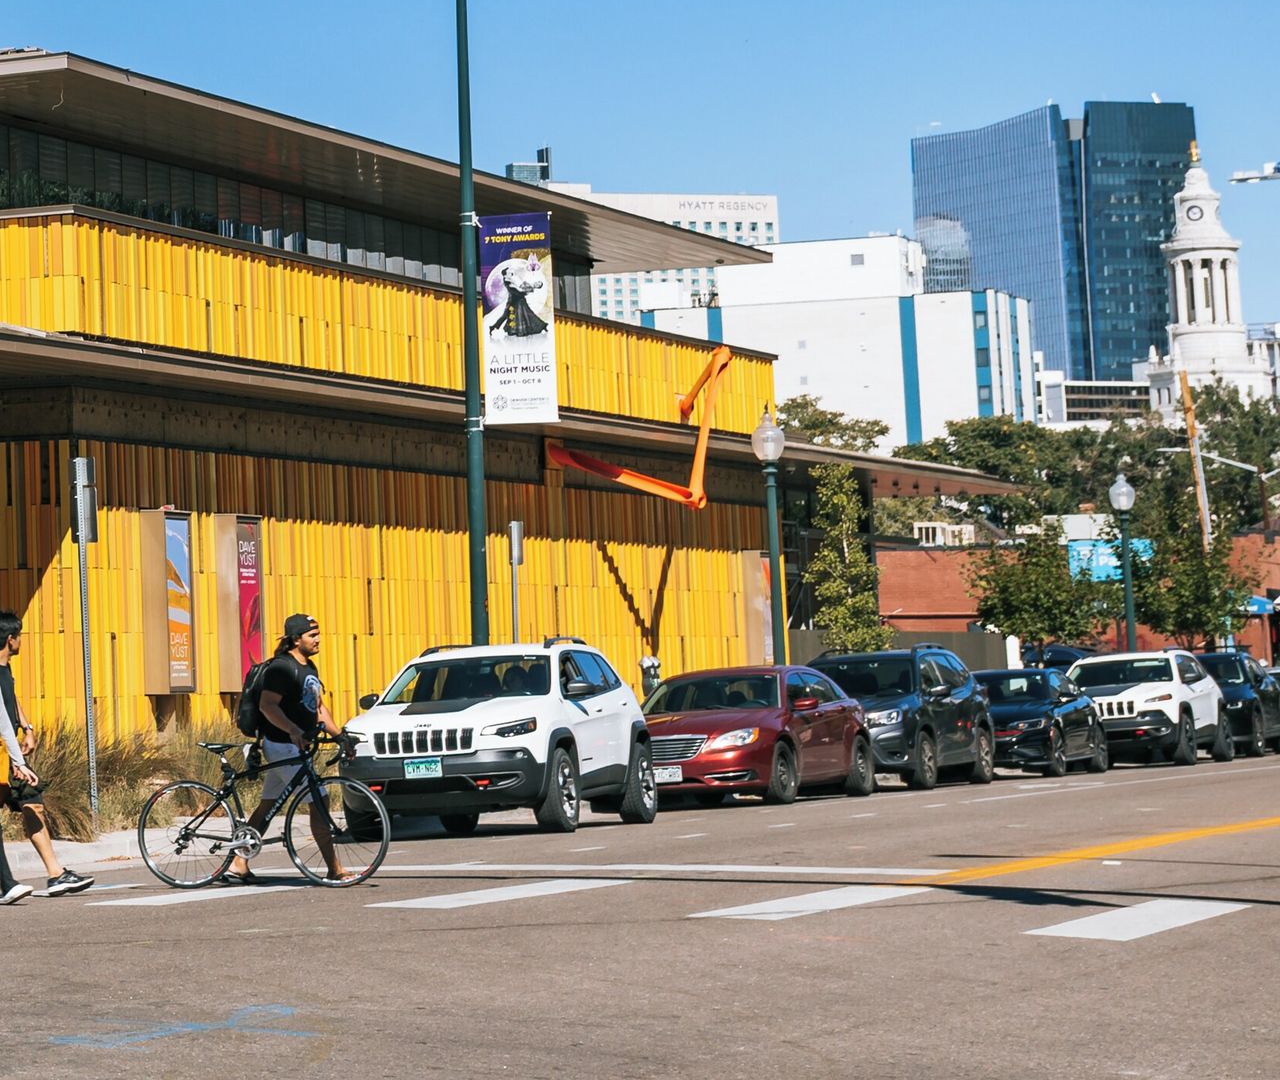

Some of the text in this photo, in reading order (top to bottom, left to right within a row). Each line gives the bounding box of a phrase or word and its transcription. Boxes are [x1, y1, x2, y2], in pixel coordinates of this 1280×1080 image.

[679, 201, 768, 211] HYATT REGENCY
[496, 226, 522, 234] WINNER
[484, 233, 545, 244] 7 TONY AWARDS
[491, 352, 549, 365] A LITTLE
[490, 365, 550, 374] NIGHT MUSIC
[239, 540, 256, 553] DAVE
[170, 632, 188, 645] DAVE
